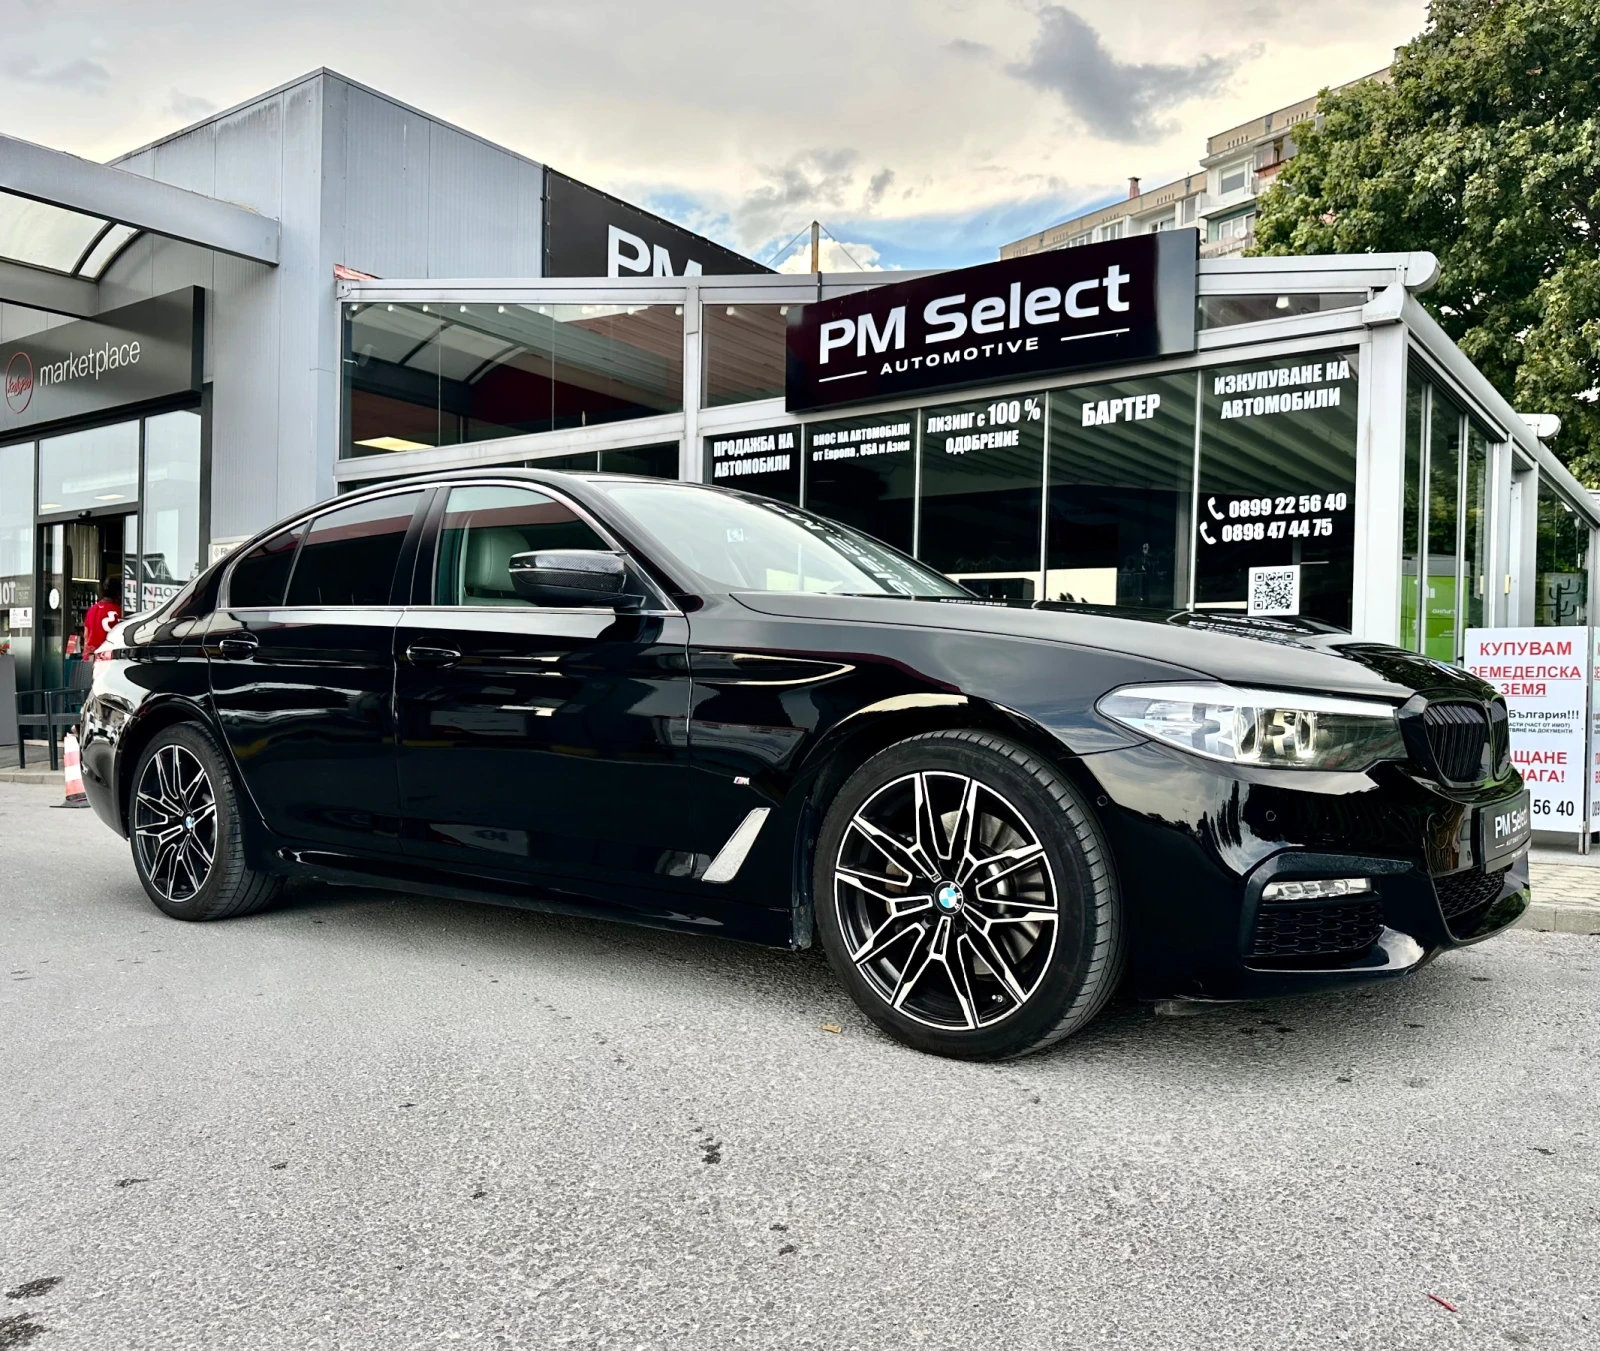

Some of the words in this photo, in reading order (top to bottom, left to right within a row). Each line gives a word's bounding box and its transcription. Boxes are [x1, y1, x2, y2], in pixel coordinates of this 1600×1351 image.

[608, 224, 702, 277] PM
[819, 306, 906, 365] PM
[923, 264, 1130, 344] Select
[40, 341, 140, 387] marketplace
[880, 337, 1039, 375] AUTOMOTIVE
[1214, 363, 1322, 395] ИЗКУПУВАНЕ
[1325, 360, 1350, 381] НА
[927, 412, 975, 433] ЛИЗИНГ
[987, 400, 1021, 426] 100
[1024, 397, 1041, 422] %
[1082, 393, 1161, 427] БАРТЕР
[1220, 387, 1341, 419] АВТОМОБИЛИ
[713, 436, 776, 457] ПРОДАЖБА
[778, 432, 794, 449] НА
[813, 434, 836, 447] ВНОС
[837, 433, 850, 446] НА
[850, 423, 910, 442] АВТОМОБИЛИ
[945, 430, 1019, 455] ОДОБРЕНИЕ
[813, 451, 823, 461] от
[860, 442, 878, 456] USA
[886, 440, 910, 453] Азия
[714, 455, 791, 478] АВТОМОБИЛИ
[1228, 497, 1272, 518] 0899
[1274, 496, 1296, 515] 22
[1299, 494, 1322, 513] 56
[1324, 492, 1347, 511] 40
[1221, 522, 1265, 542] 0898
[1267, 521, 1287, 539] 47
[1288, 519, 1310, 538] 44
[1312, 518, 1333, 536] 75
[1480, 641, 1572, 656] КУПУВАМ
[1469, 665, 1582, 680] ЗЕМЕДЕЛСКА
[1500, 683, 1546, 695] ЗЕМЯ
[1508, 709, 1579, 721] България!!!
[1533, 799, 1551, 815] 56
[1556, 801, 1574, 816] 40
[1494, 812, 1511, 839] PM
[1511, 803, 1528, 832] Select
